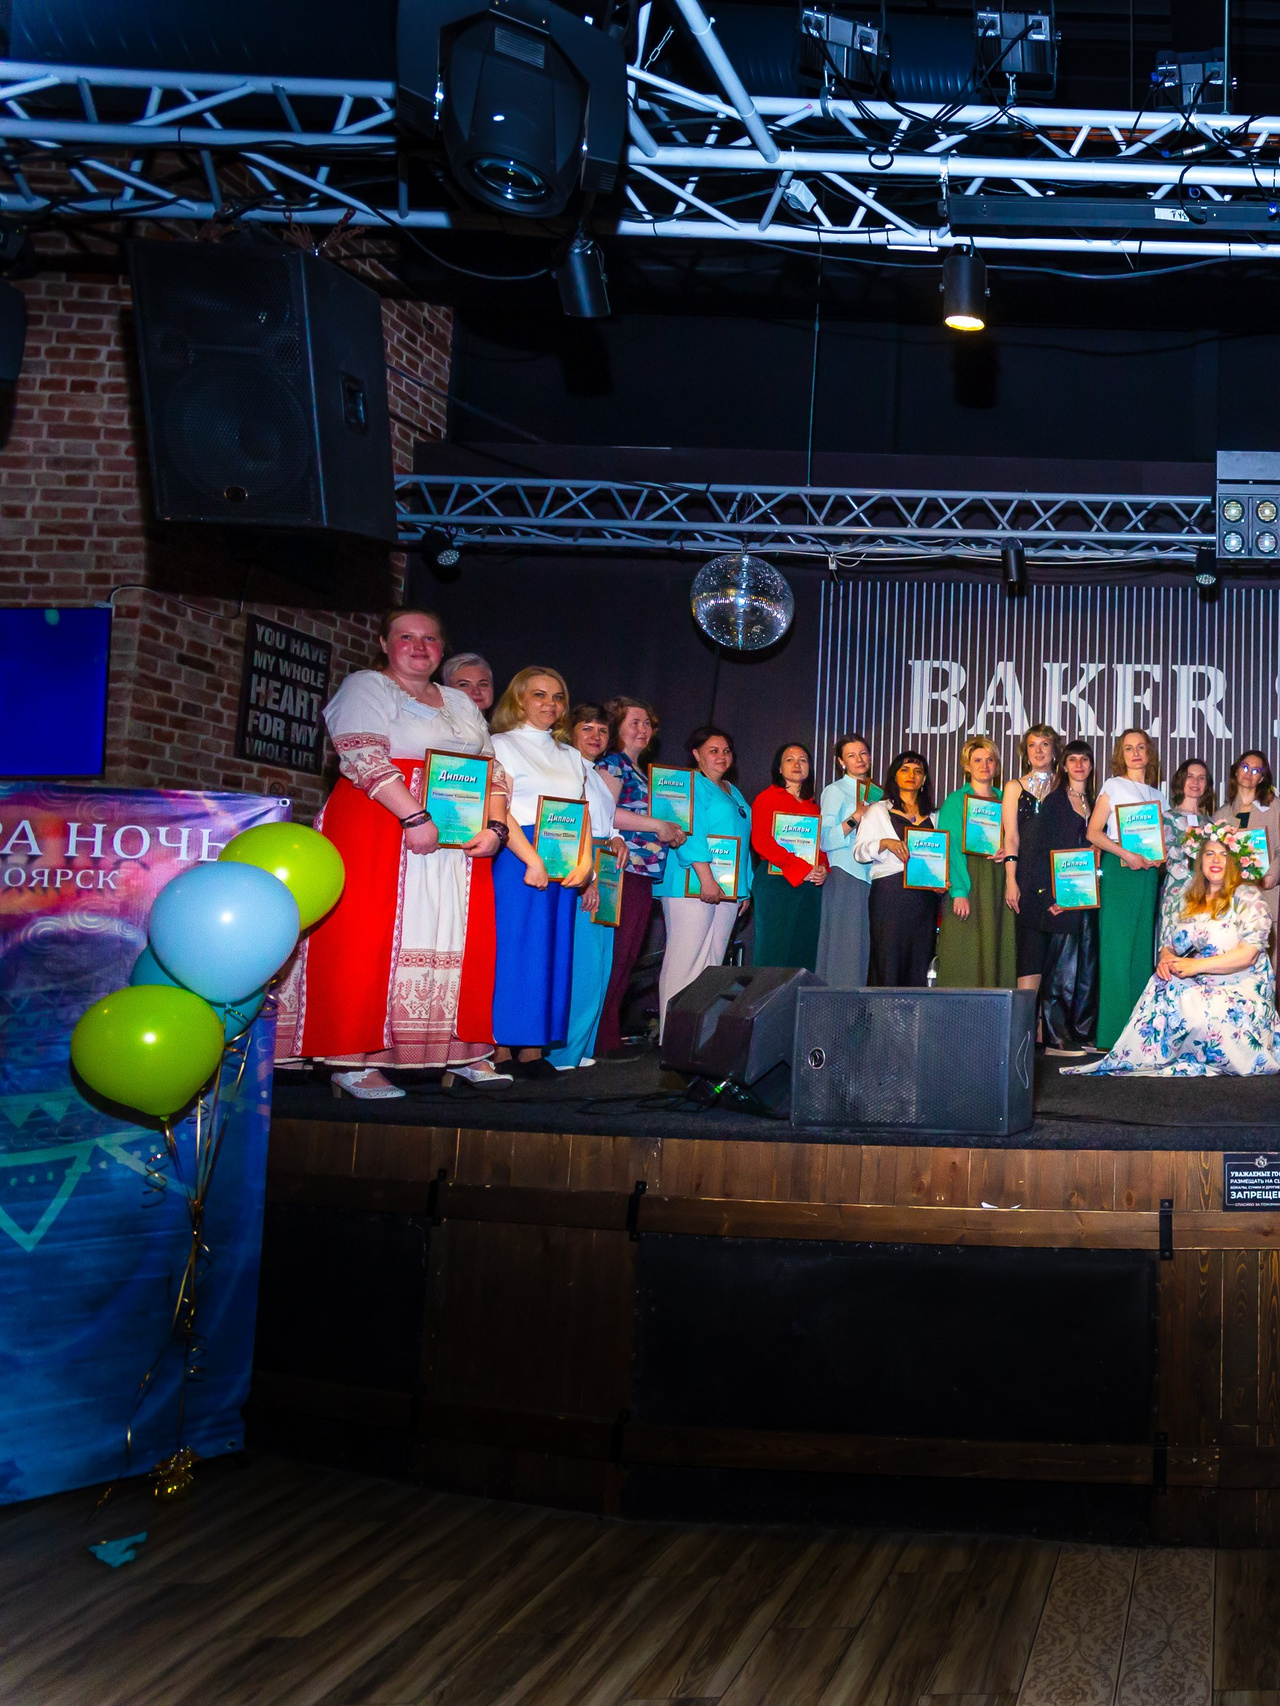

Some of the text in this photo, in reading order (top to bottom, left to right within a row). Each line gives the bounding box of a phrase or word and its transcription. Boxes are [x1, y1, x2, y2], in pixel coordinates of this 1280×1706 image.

[255, 623, 327, 665] YOU HAVE
[253, 650, 325, 689] MY WHOLE
[250, 673, 323, 723] HEART
[905, 660, 1234, 739] BAKER
[247, 709, 319, 748] FOR MY
[245, 736, 290, 764] WHOLE
[438, 770, 477, 784] Диплом
[658, 777, 685, 788] Диплом
[547, 813, 577, 824] Диплом
[973, 807, 997, 816] Диплом
[1126, 814, 1153, 823] Диплом
[782, 824, 812, 833] Диплом
[0, 819, 227, 863] А НОЧЬ
[914, 839, 940, 849] Диплом
[1061, 860, 1088, 869] Диплом
[4, 867, 119, 890] ОЯРСК
